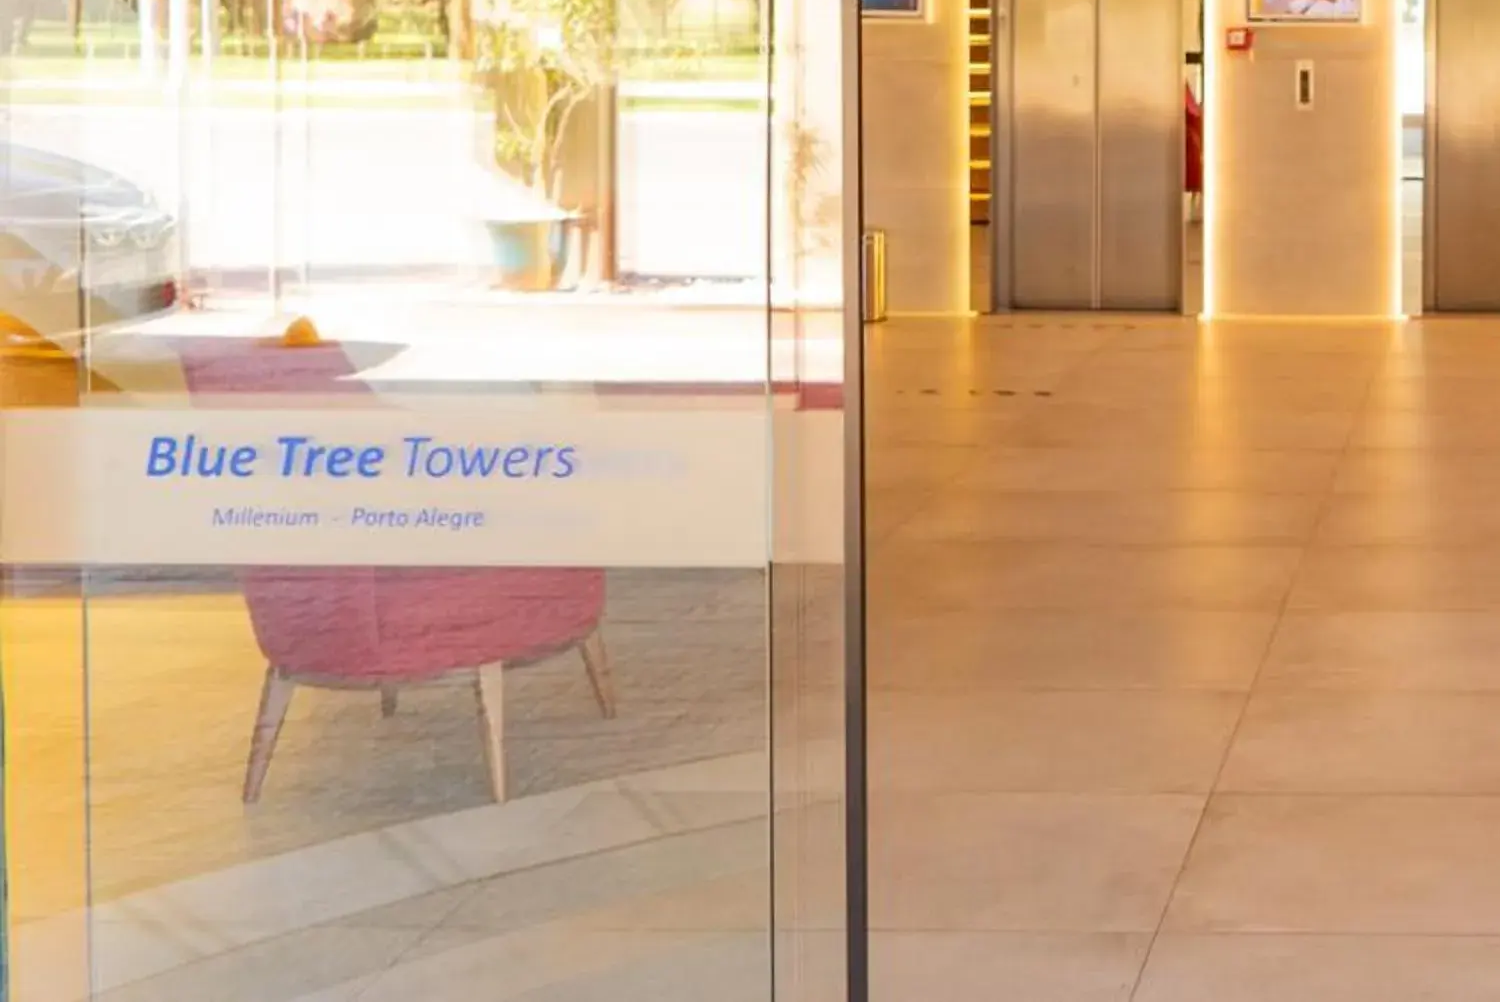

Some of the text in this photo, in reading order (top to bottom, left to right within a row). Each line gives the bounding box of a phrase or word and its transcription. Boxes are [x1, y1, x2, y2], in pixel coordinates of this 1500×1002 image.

[146, 435, 576, 478] Blue Tree Towers
[212, 508, 319, 527] Millenium
[351, 508, 409, 527] Porto
[415, 507, 485, 531] Alegre
